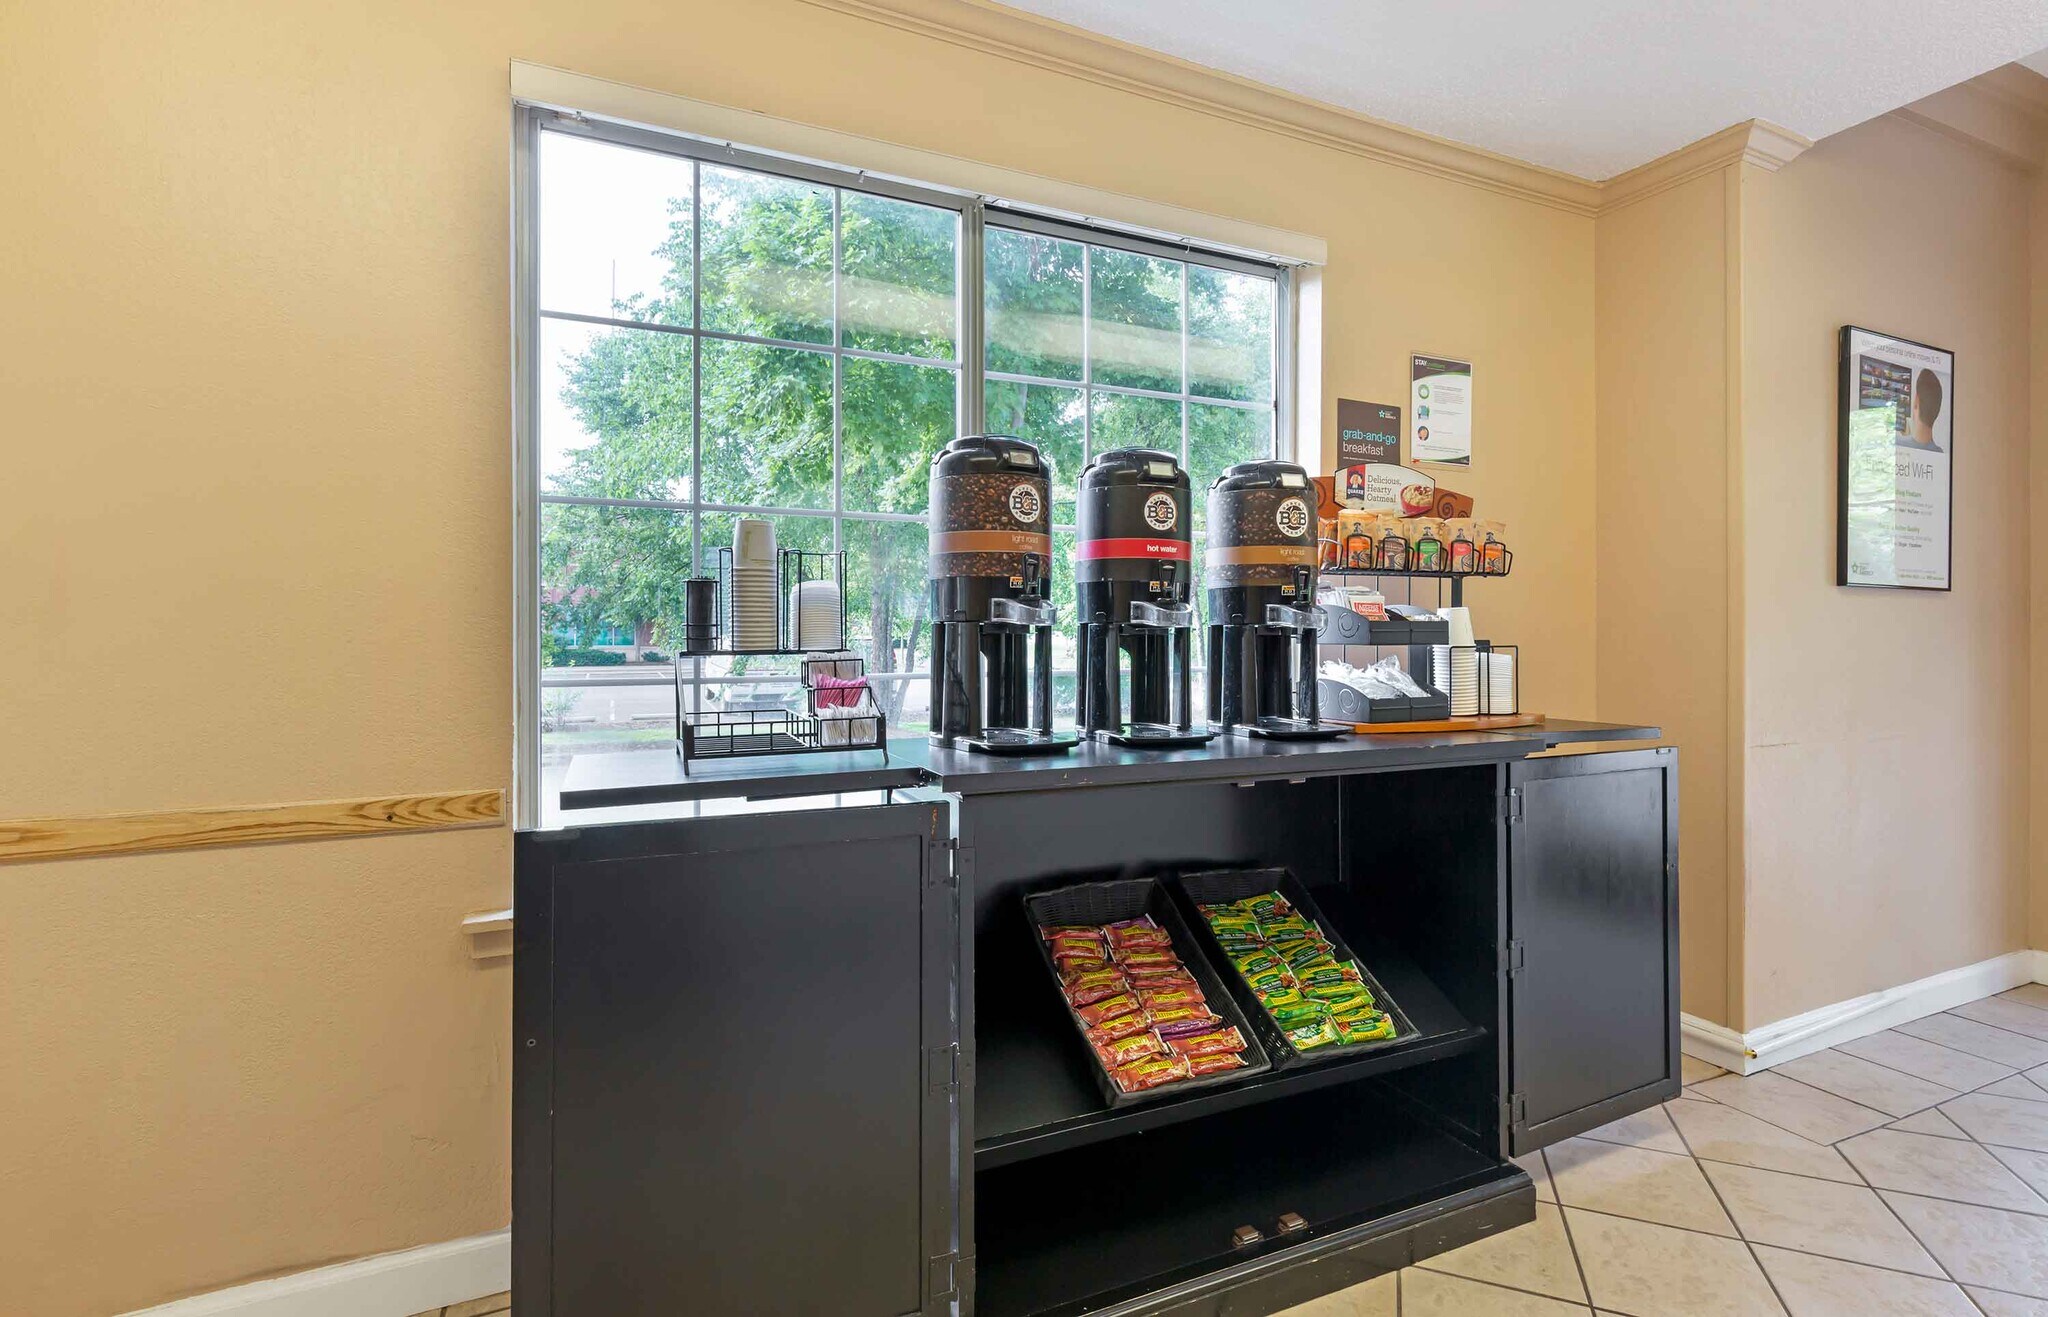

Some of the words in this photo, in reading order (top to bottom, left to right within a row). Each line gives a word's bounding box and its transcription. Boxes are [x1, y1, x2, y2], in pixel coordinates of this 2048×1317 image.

[1343, 429, 1397, 446] grab-and-go
[1343, 441, 1384, 457] breakfast
[1911, 461, 1934, 481] Wi-Fi
[1367, 475, 1402, 486] Delicious,
[1367, 484, 1392, 496] Hearty
[1012, 496, 1039, 512] B&B
[1366, 493, 1397, 504] Oatmeal
[1147, 504, 1175, 520] B&B
[1279, 510, 1307, 526] B&B
[1147, 544, 1159, 552] hot
[1160, 545, 1178, 553] water
